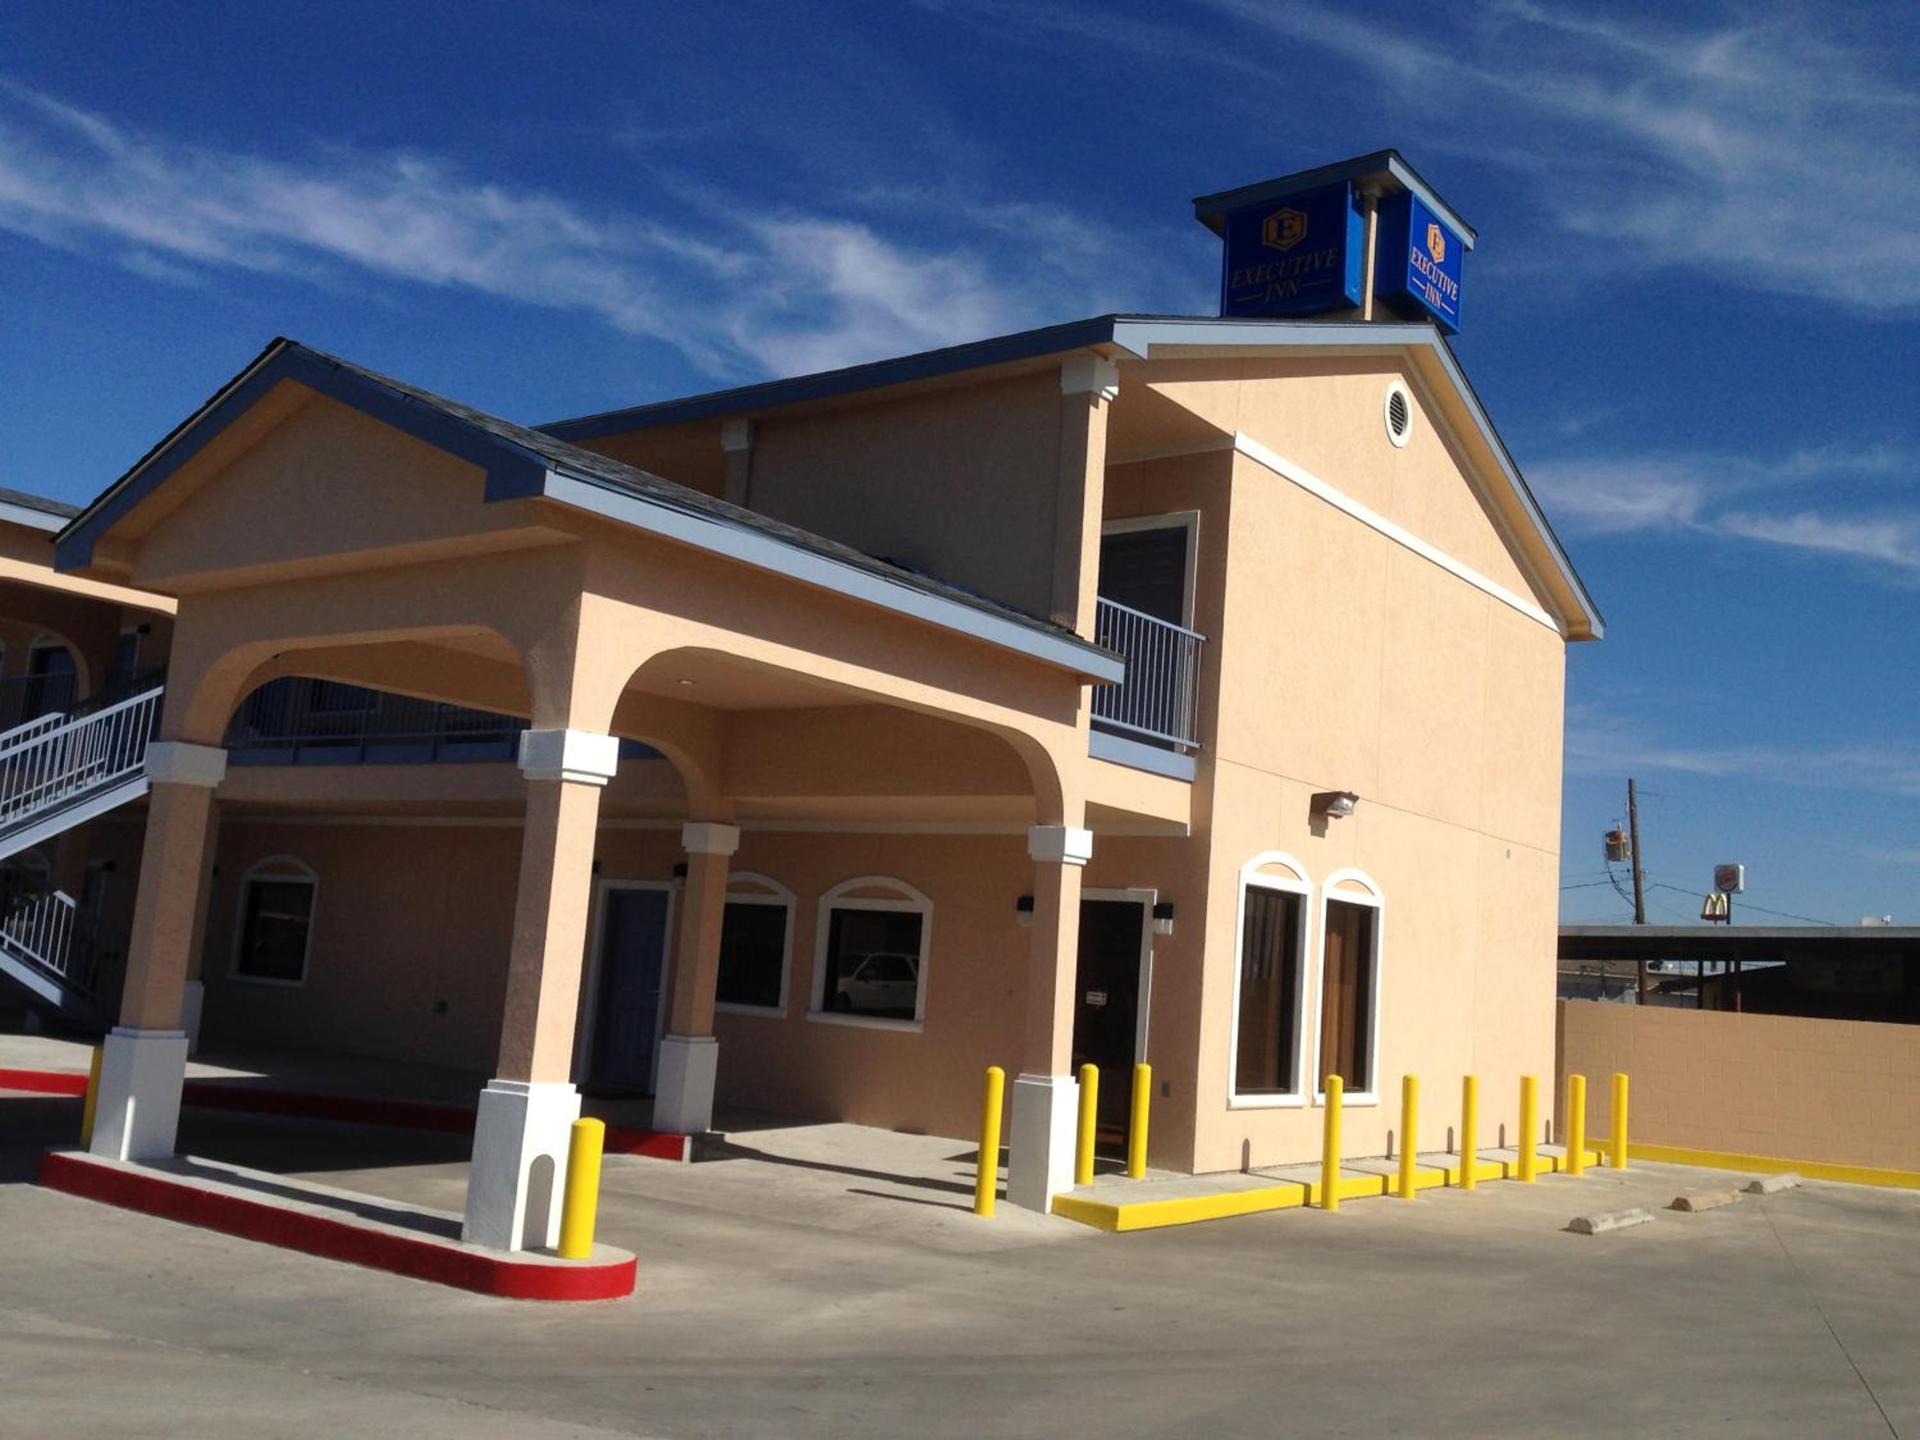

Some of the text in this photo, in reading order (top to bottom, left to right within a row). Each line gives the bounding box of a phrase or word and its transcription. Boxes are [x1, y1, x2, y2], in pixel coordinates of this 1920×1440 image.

[1275, 217, 1298, 242] E
[1232, 247, 1338, 289] EXECUTIVE
[1411, 247, 1459, 301] EXECUTIVE
[1265, 280, 1300, 302] INN
[1425, 282, 1442, 309] INN
